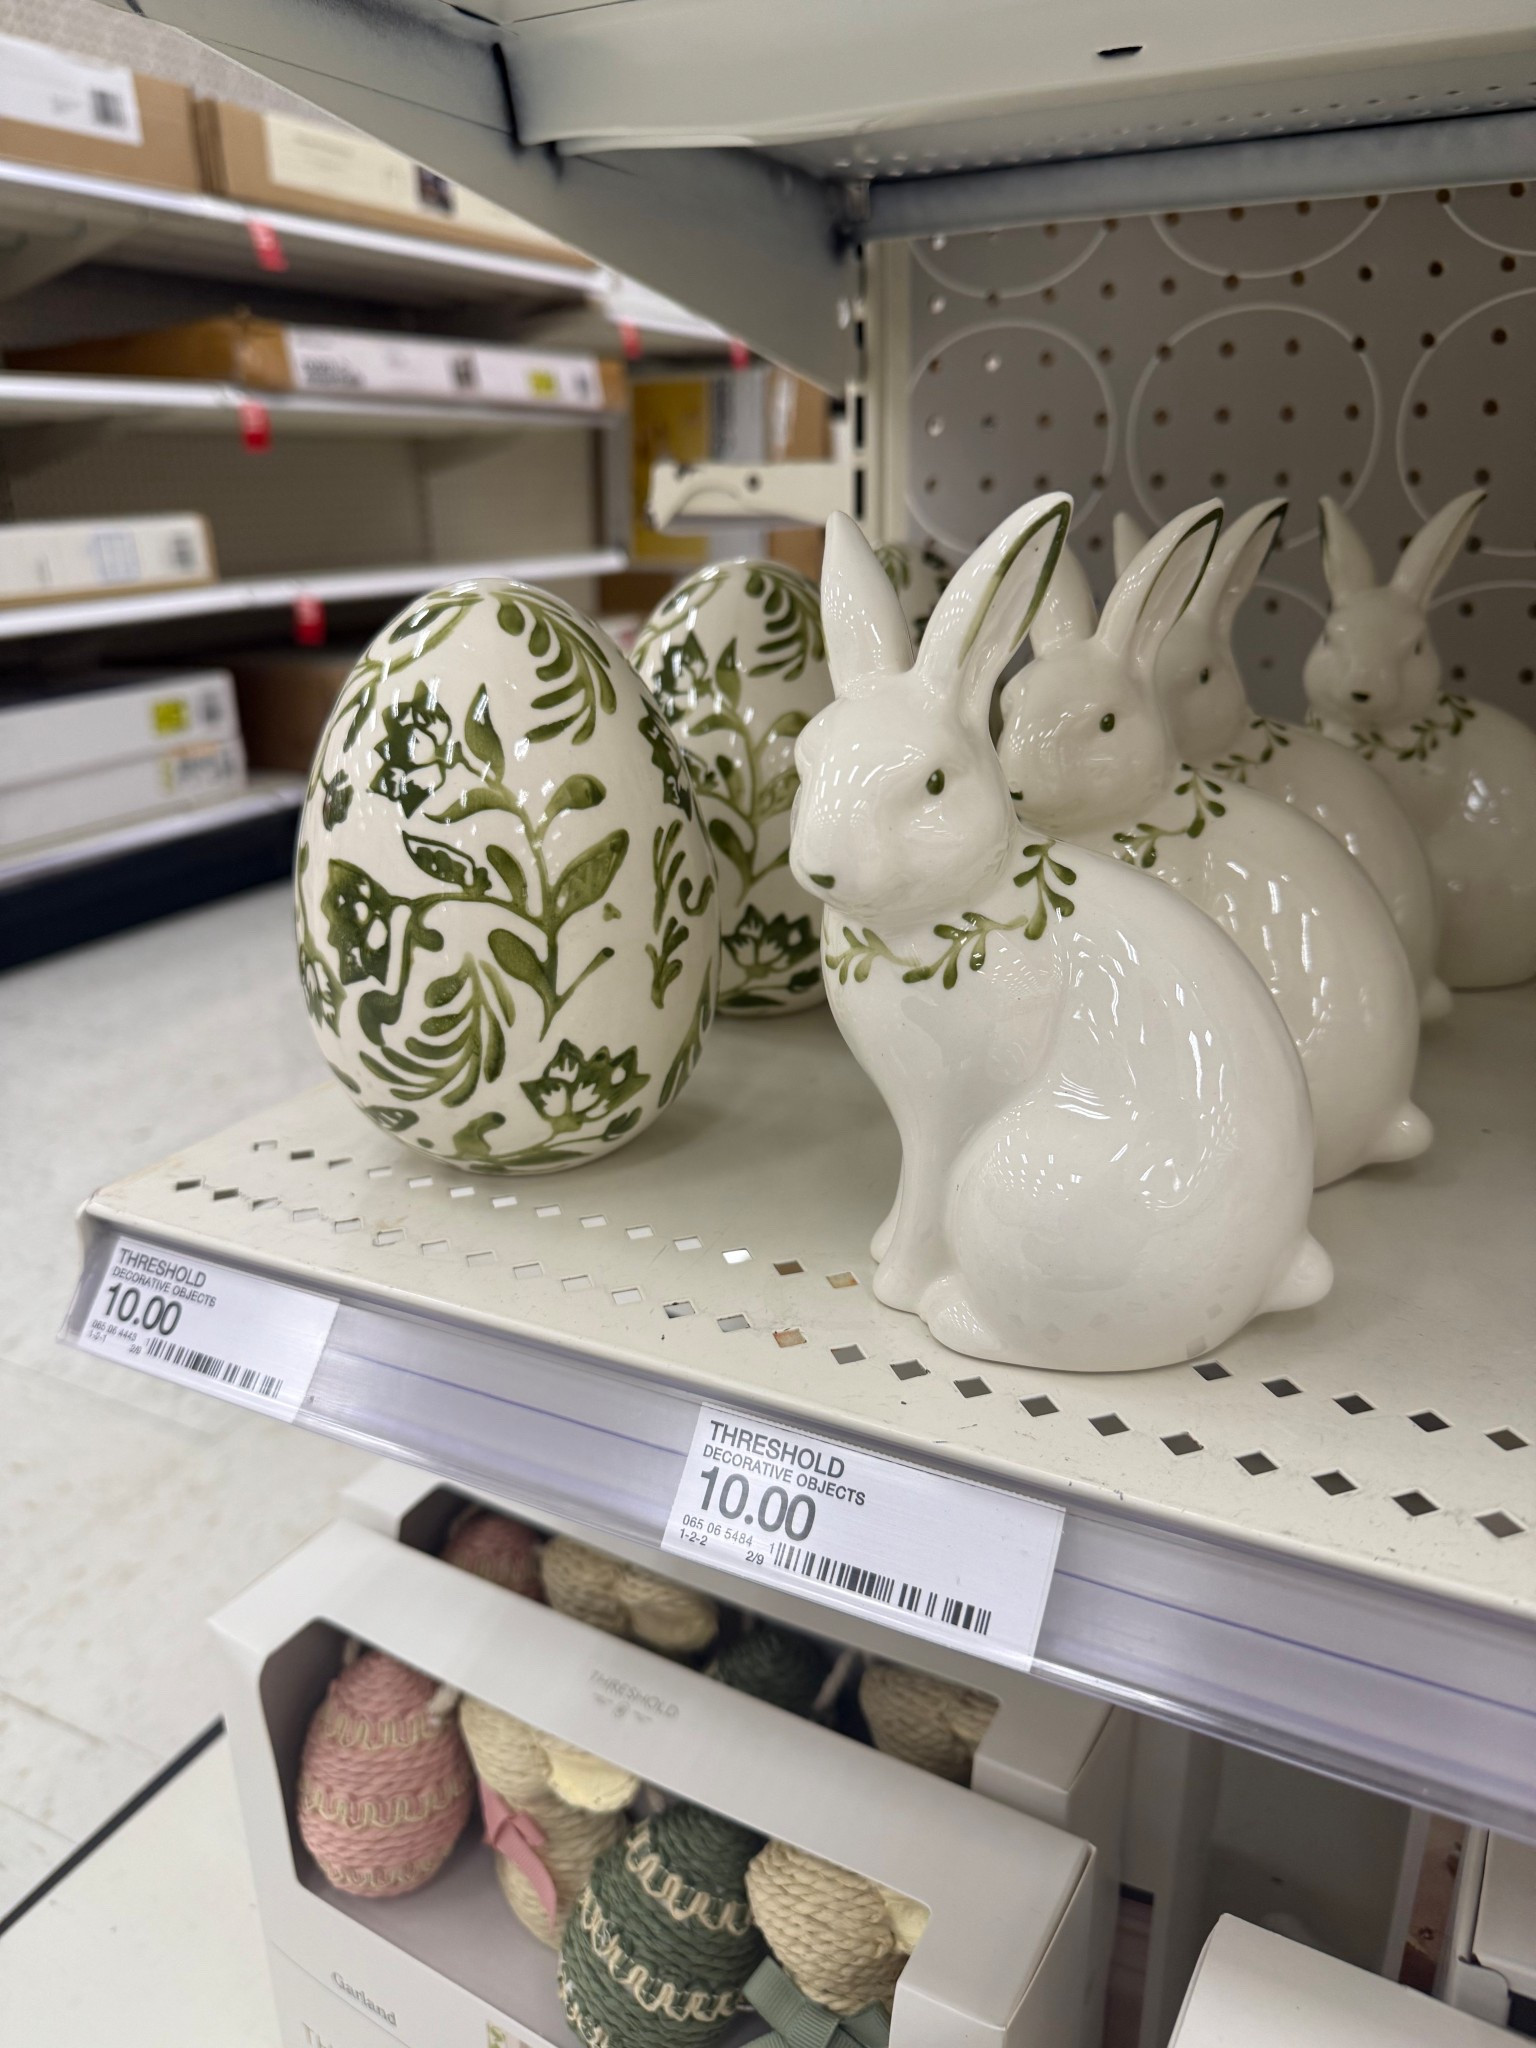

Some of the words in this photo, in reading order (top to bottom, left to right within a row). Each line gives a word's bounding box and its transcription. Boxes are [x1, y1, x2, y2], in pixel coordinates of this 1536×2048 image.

[112, 1266, 170, 1293] DECORATIVE
[172, 1285, 217, 1307] OBJECTS
[120, 1248, 207, 1287] THRESHOLD
[102, 1283, 182, 1335] 10.00
[710, 1420, 845, 1479] THRESHOLD
[703, 1445, 794, 1484] DECORATIVE
[796, 1474, 866, 1506] OBJECTS
[699, 1466, 816, 1542] 10.00
[680, 1528, 708, 1546] 1-2-2
[683, 1514, 704, 1530] 065
[707, 1522, 722, 1536] 06
[724, 1528, 753, 1547] 5484
[745, 1550, 765, 1565] 2/9
[589, 1670, 680, 1718] THRESHOLD
[331, 1971, 397, 2027] Garland
